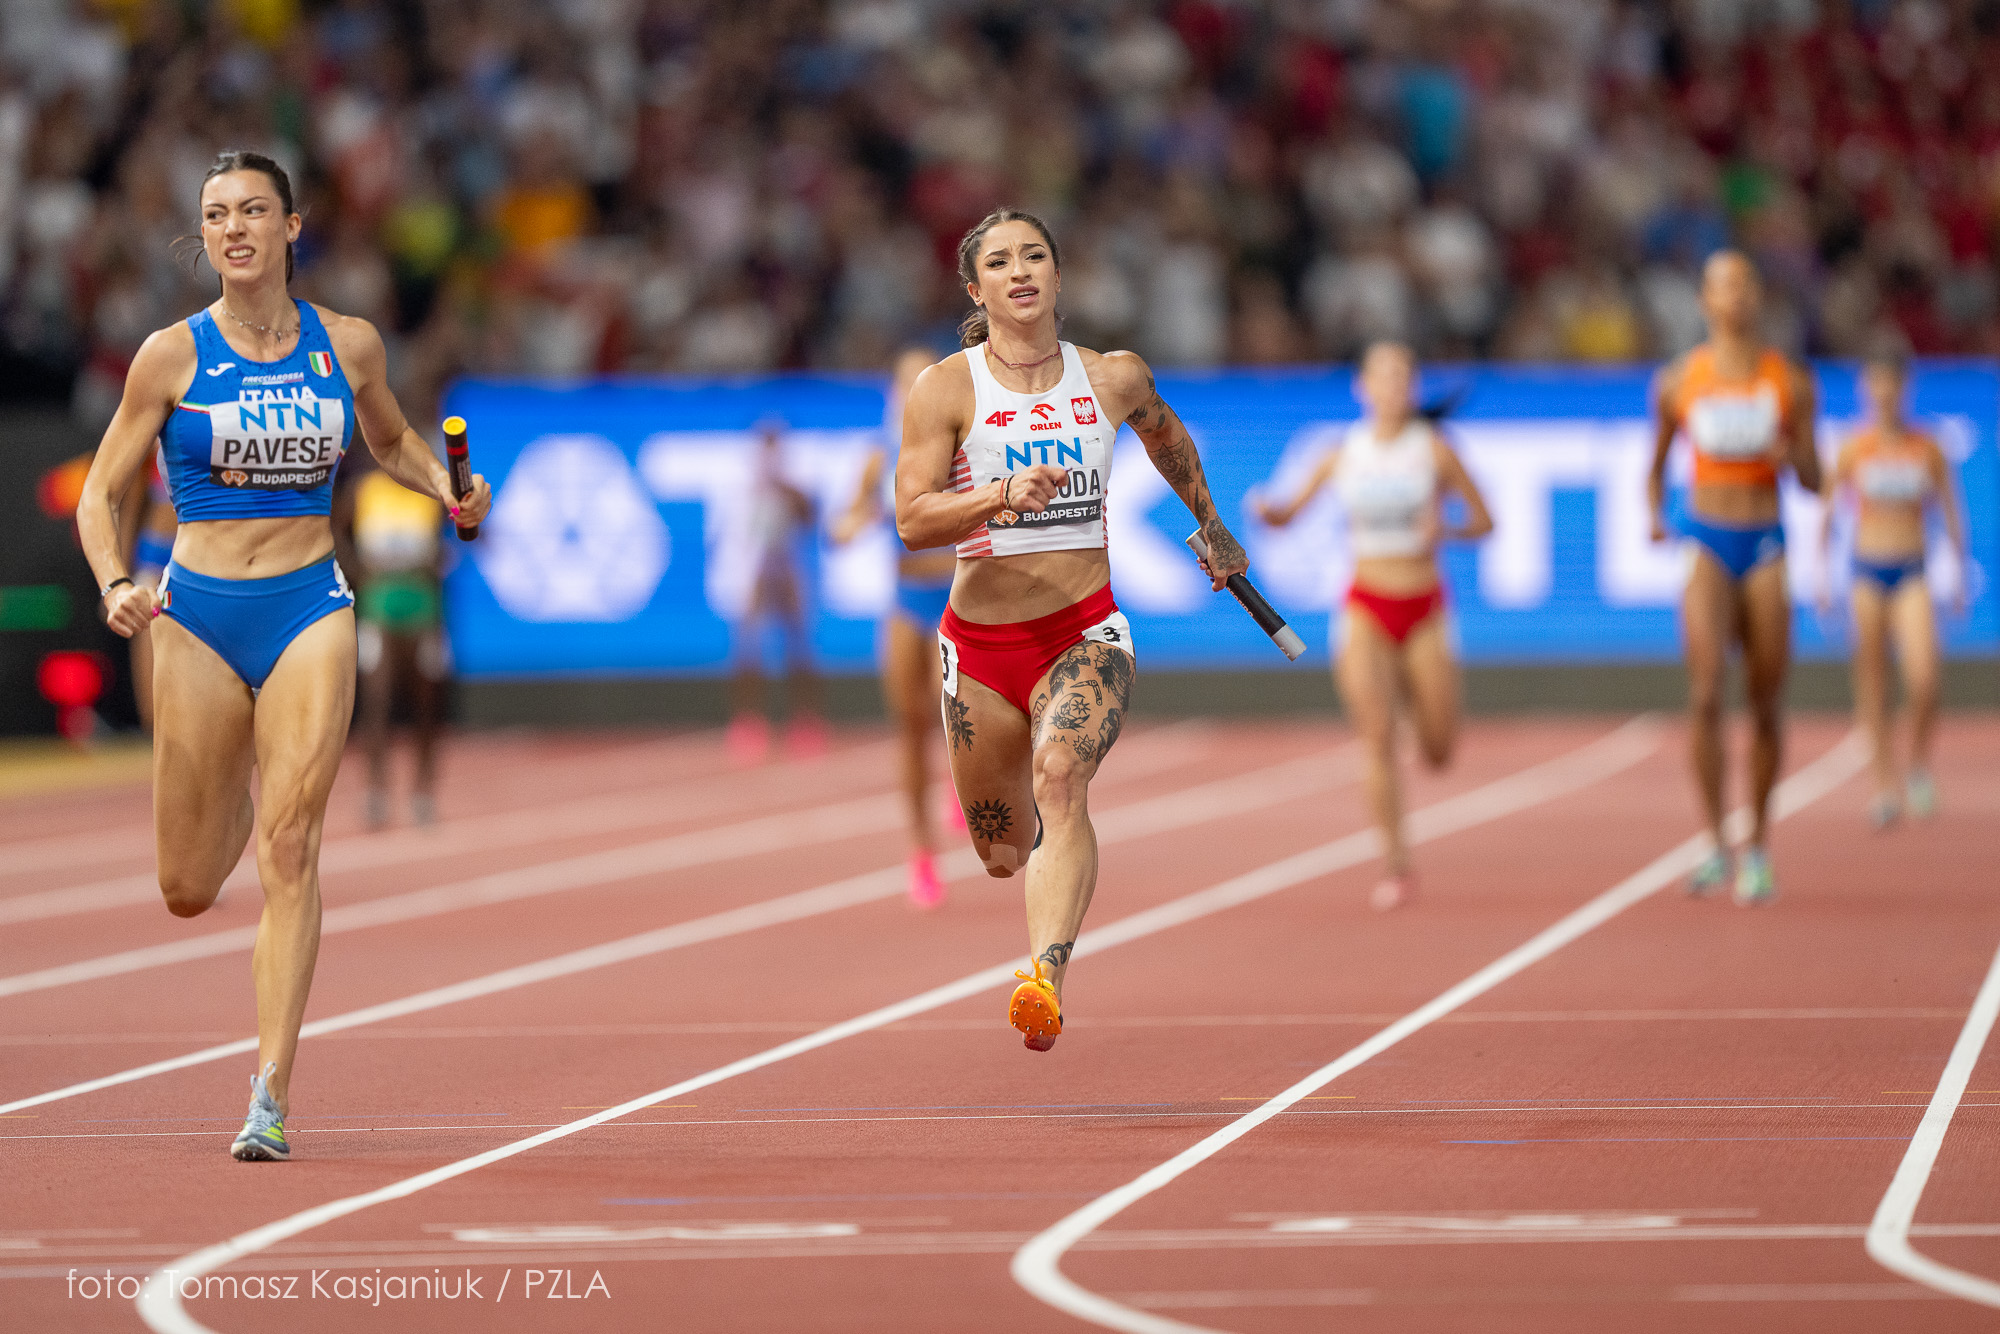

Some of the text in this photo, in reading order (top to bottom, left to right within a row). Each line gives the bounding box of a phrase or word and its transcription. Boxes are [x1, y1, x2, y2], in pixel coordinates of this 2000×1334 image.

[239, 386, 318, 402] ITALIA
[239, 402, 321, 432] NTN
[985, 411, 1017, 427] 4F
[1030, 421, 1062, 431] ORLEN
[223, 437, 332, 464] PAVESE
[1006, 437, 1083, 472] NTN
[252, 472, 316, 485] BUDAPEST
[1023, 507, 1088, 521] BUDAPEST
